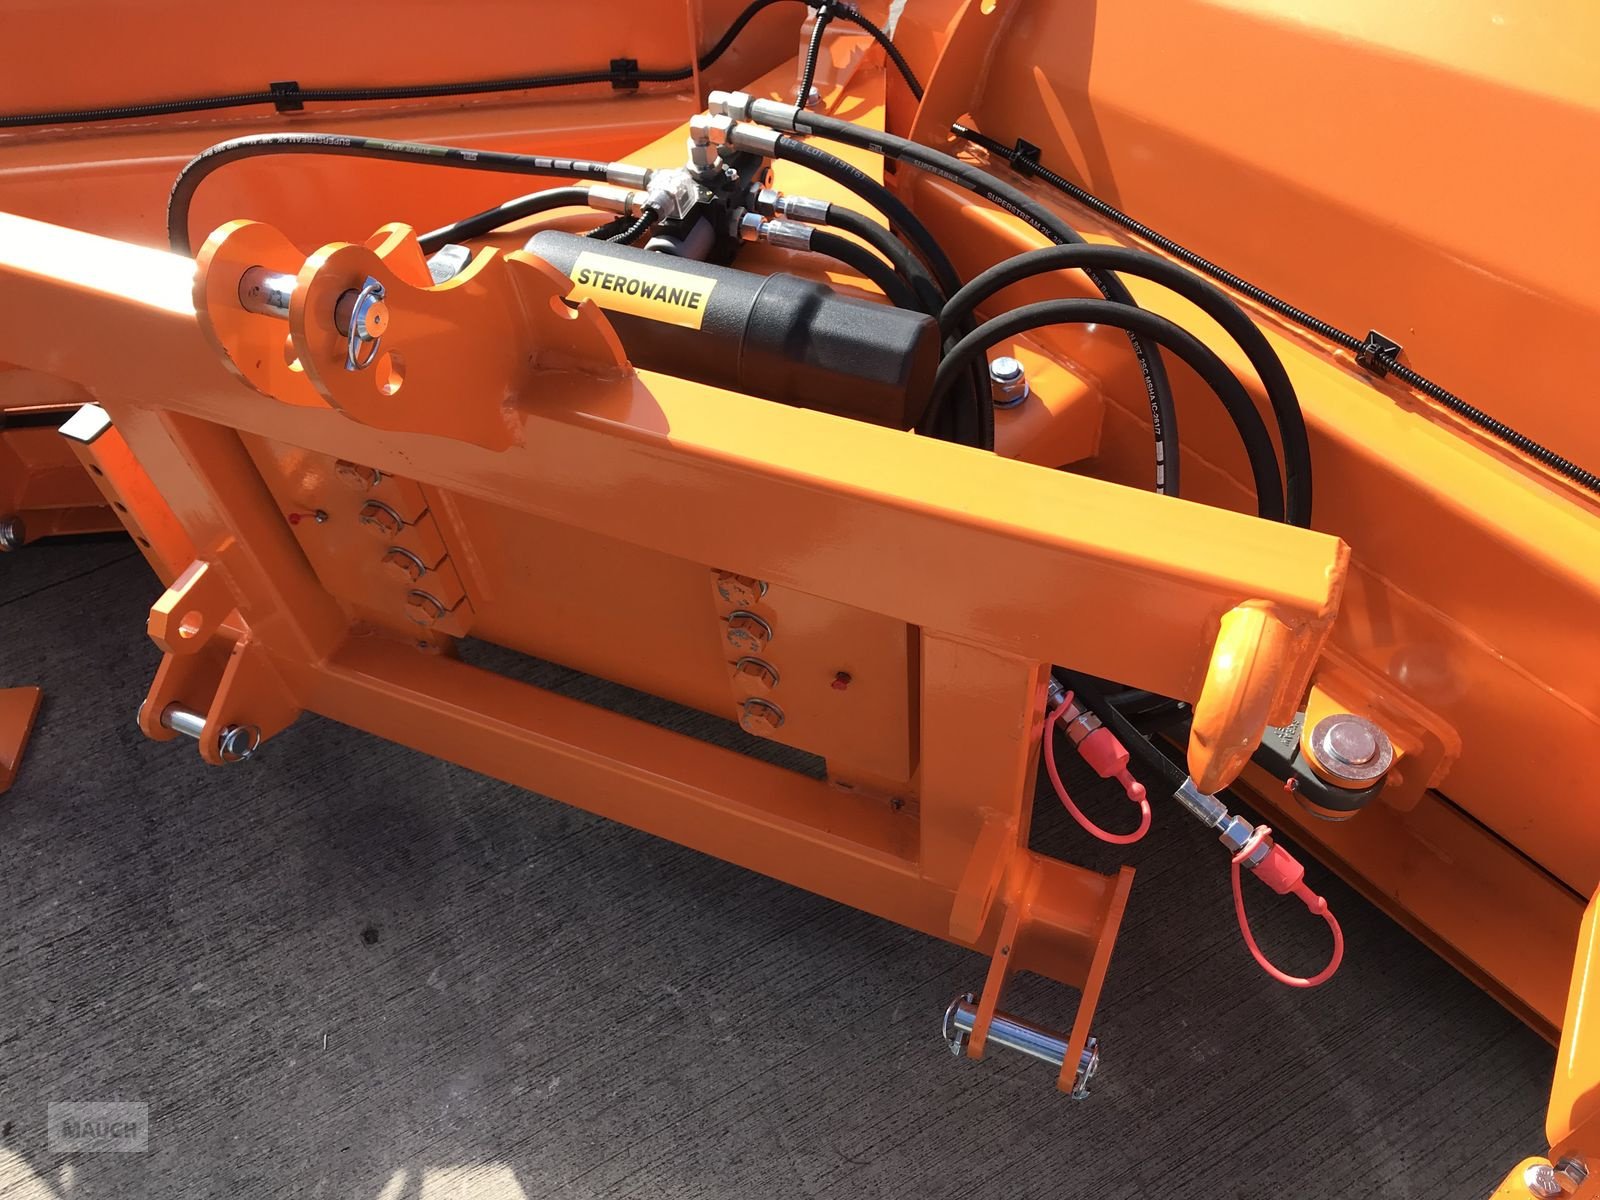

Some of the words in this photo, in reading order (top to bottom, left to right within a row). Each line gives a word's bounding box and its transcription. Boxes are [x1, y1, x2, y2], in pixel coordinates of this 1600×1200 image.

[290, 136, 351, 147] SUPERSTREAM
[914, 159, 938, 174] SUPER
[986, 191, 1041, 230] SUPERSTREAM
[577, 268, 702, 310] STEROWANIE
[1140, 358, 1149, 375] 2SC
[1144, 375, 1156, 401] MSHA
